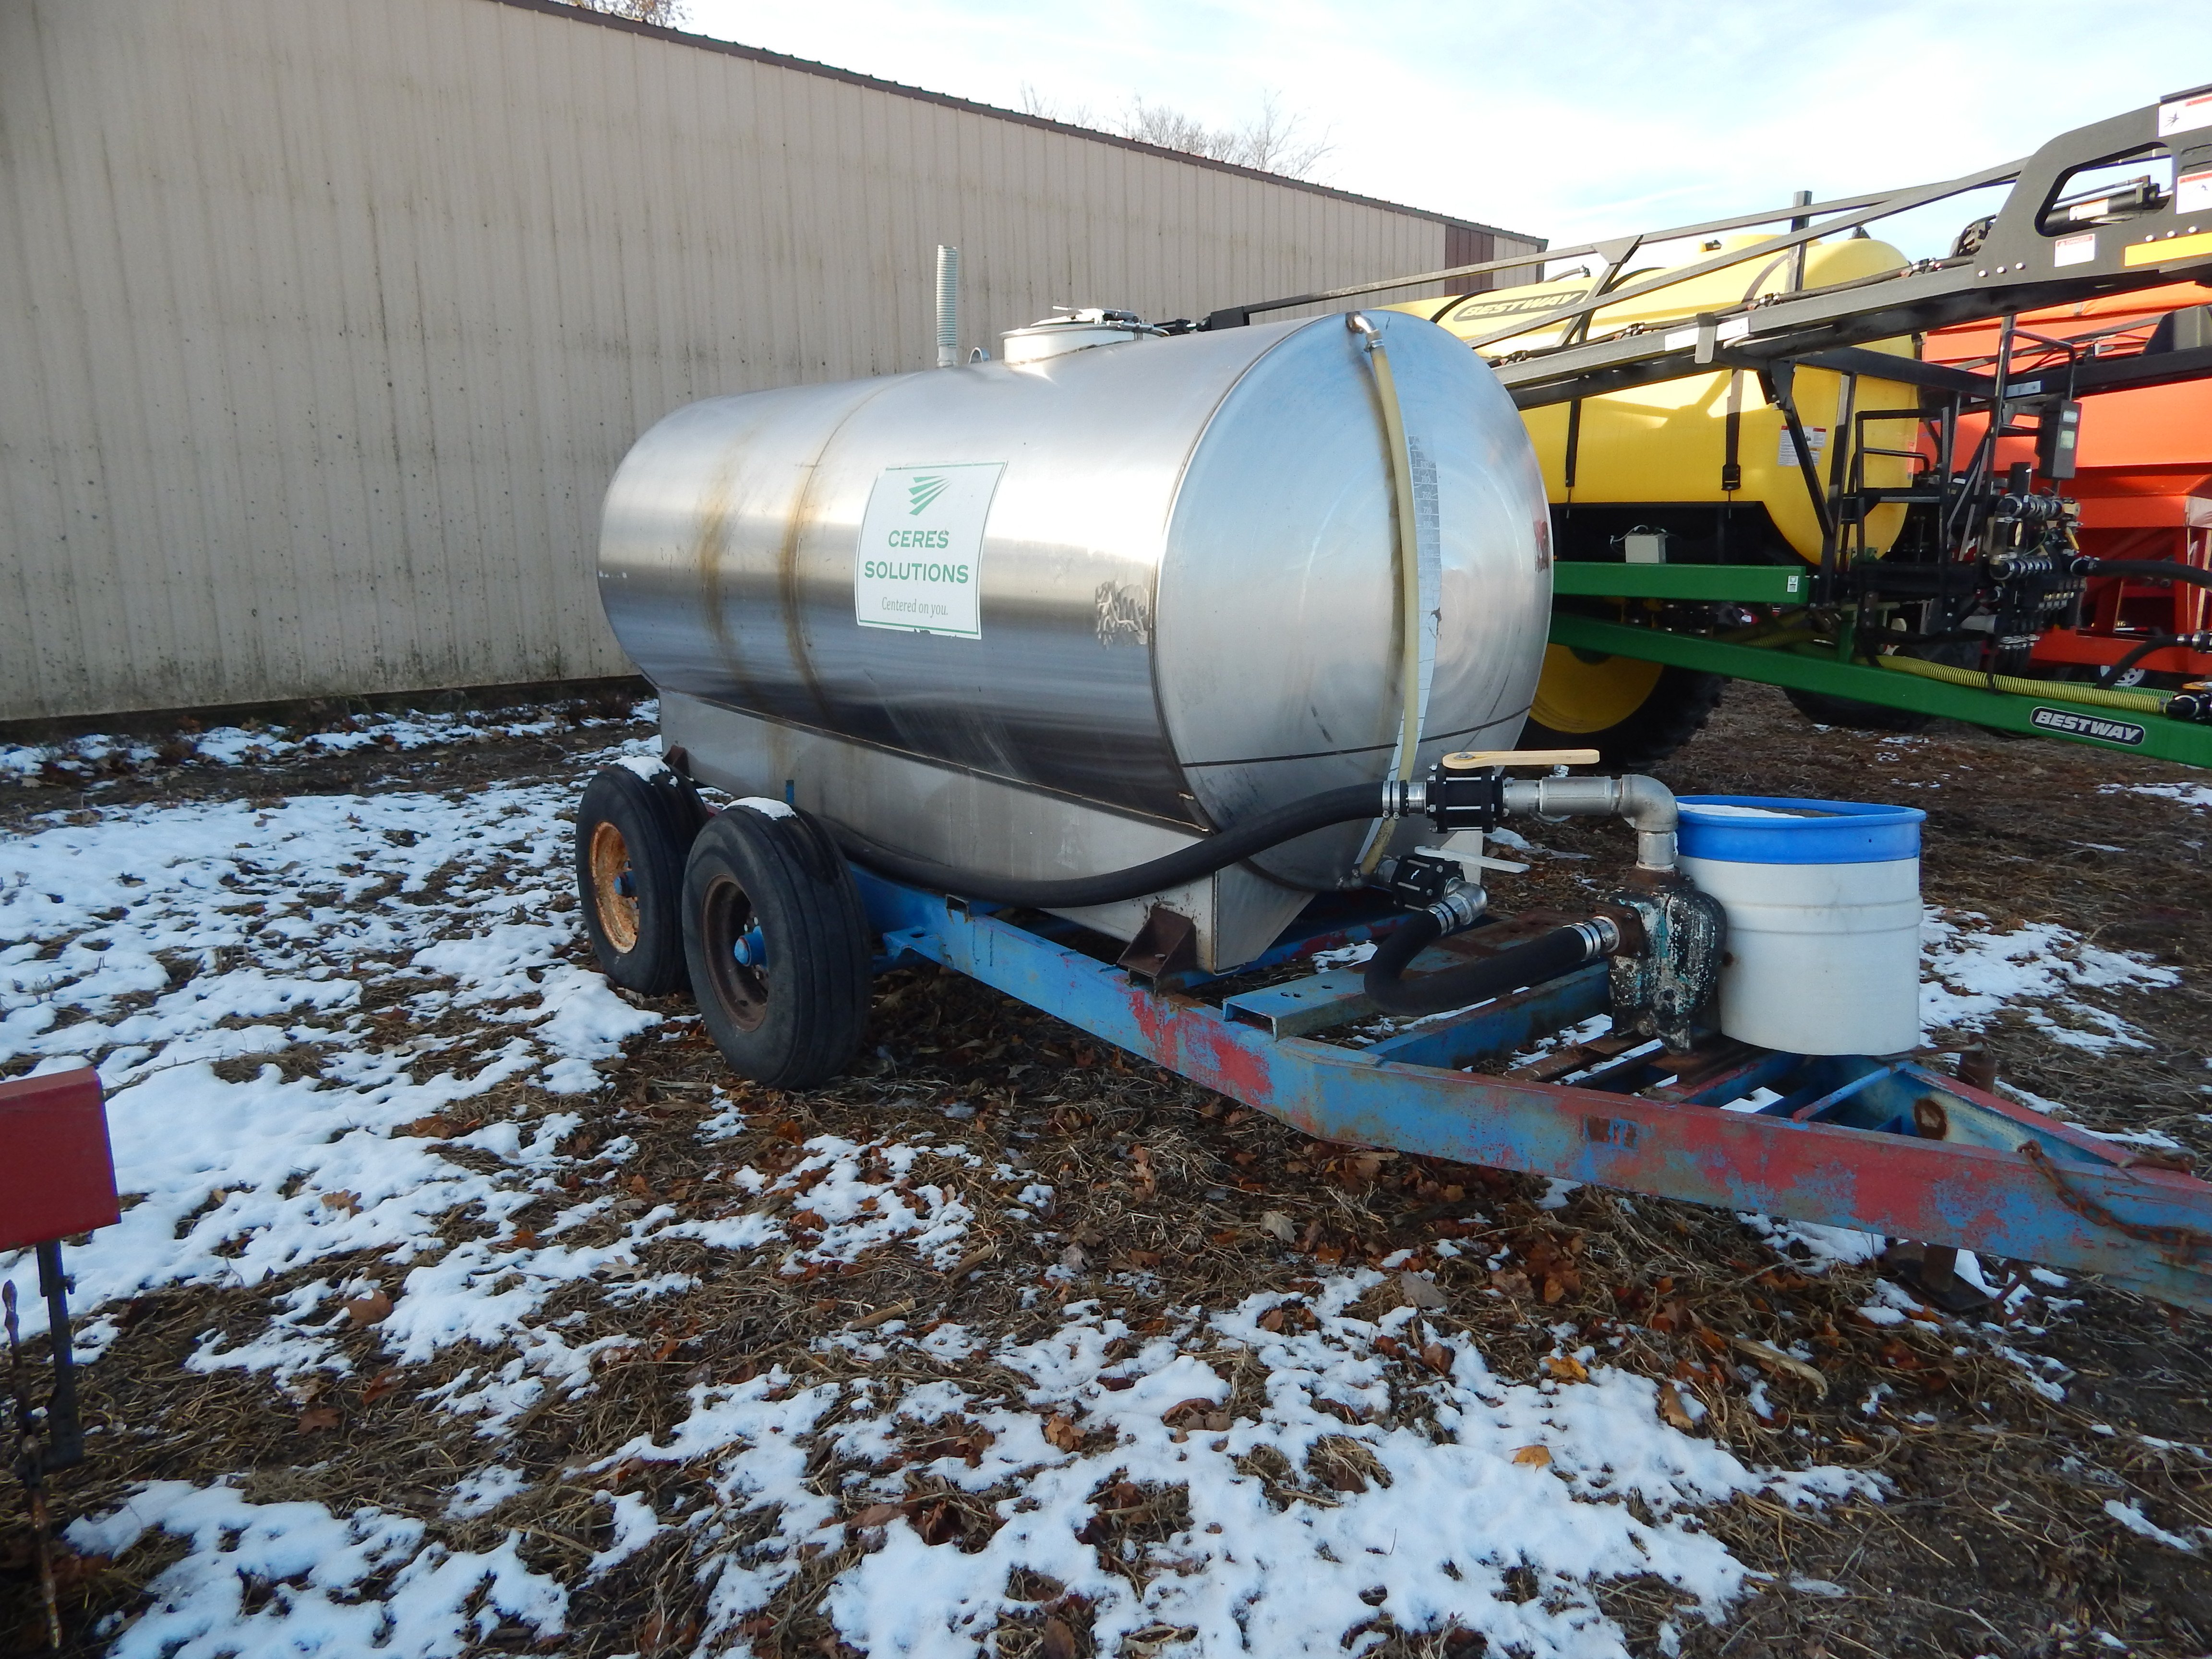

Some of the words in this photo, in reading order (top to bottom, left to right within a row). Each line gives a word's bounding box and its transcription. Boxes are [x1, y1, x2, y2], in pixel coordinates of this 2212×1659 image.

[1459, 293, 1582, 317] BESTWAY
[888, 530, 950, 548] CERES
[865, 561, 969, 584] SOLUTIONS
[881, 596, 916, 613] Centered
[919, 602, 929, 614] on
[930, 603, 949, 618] you.
[2035, 711, 2141, 740] BESTWAY
